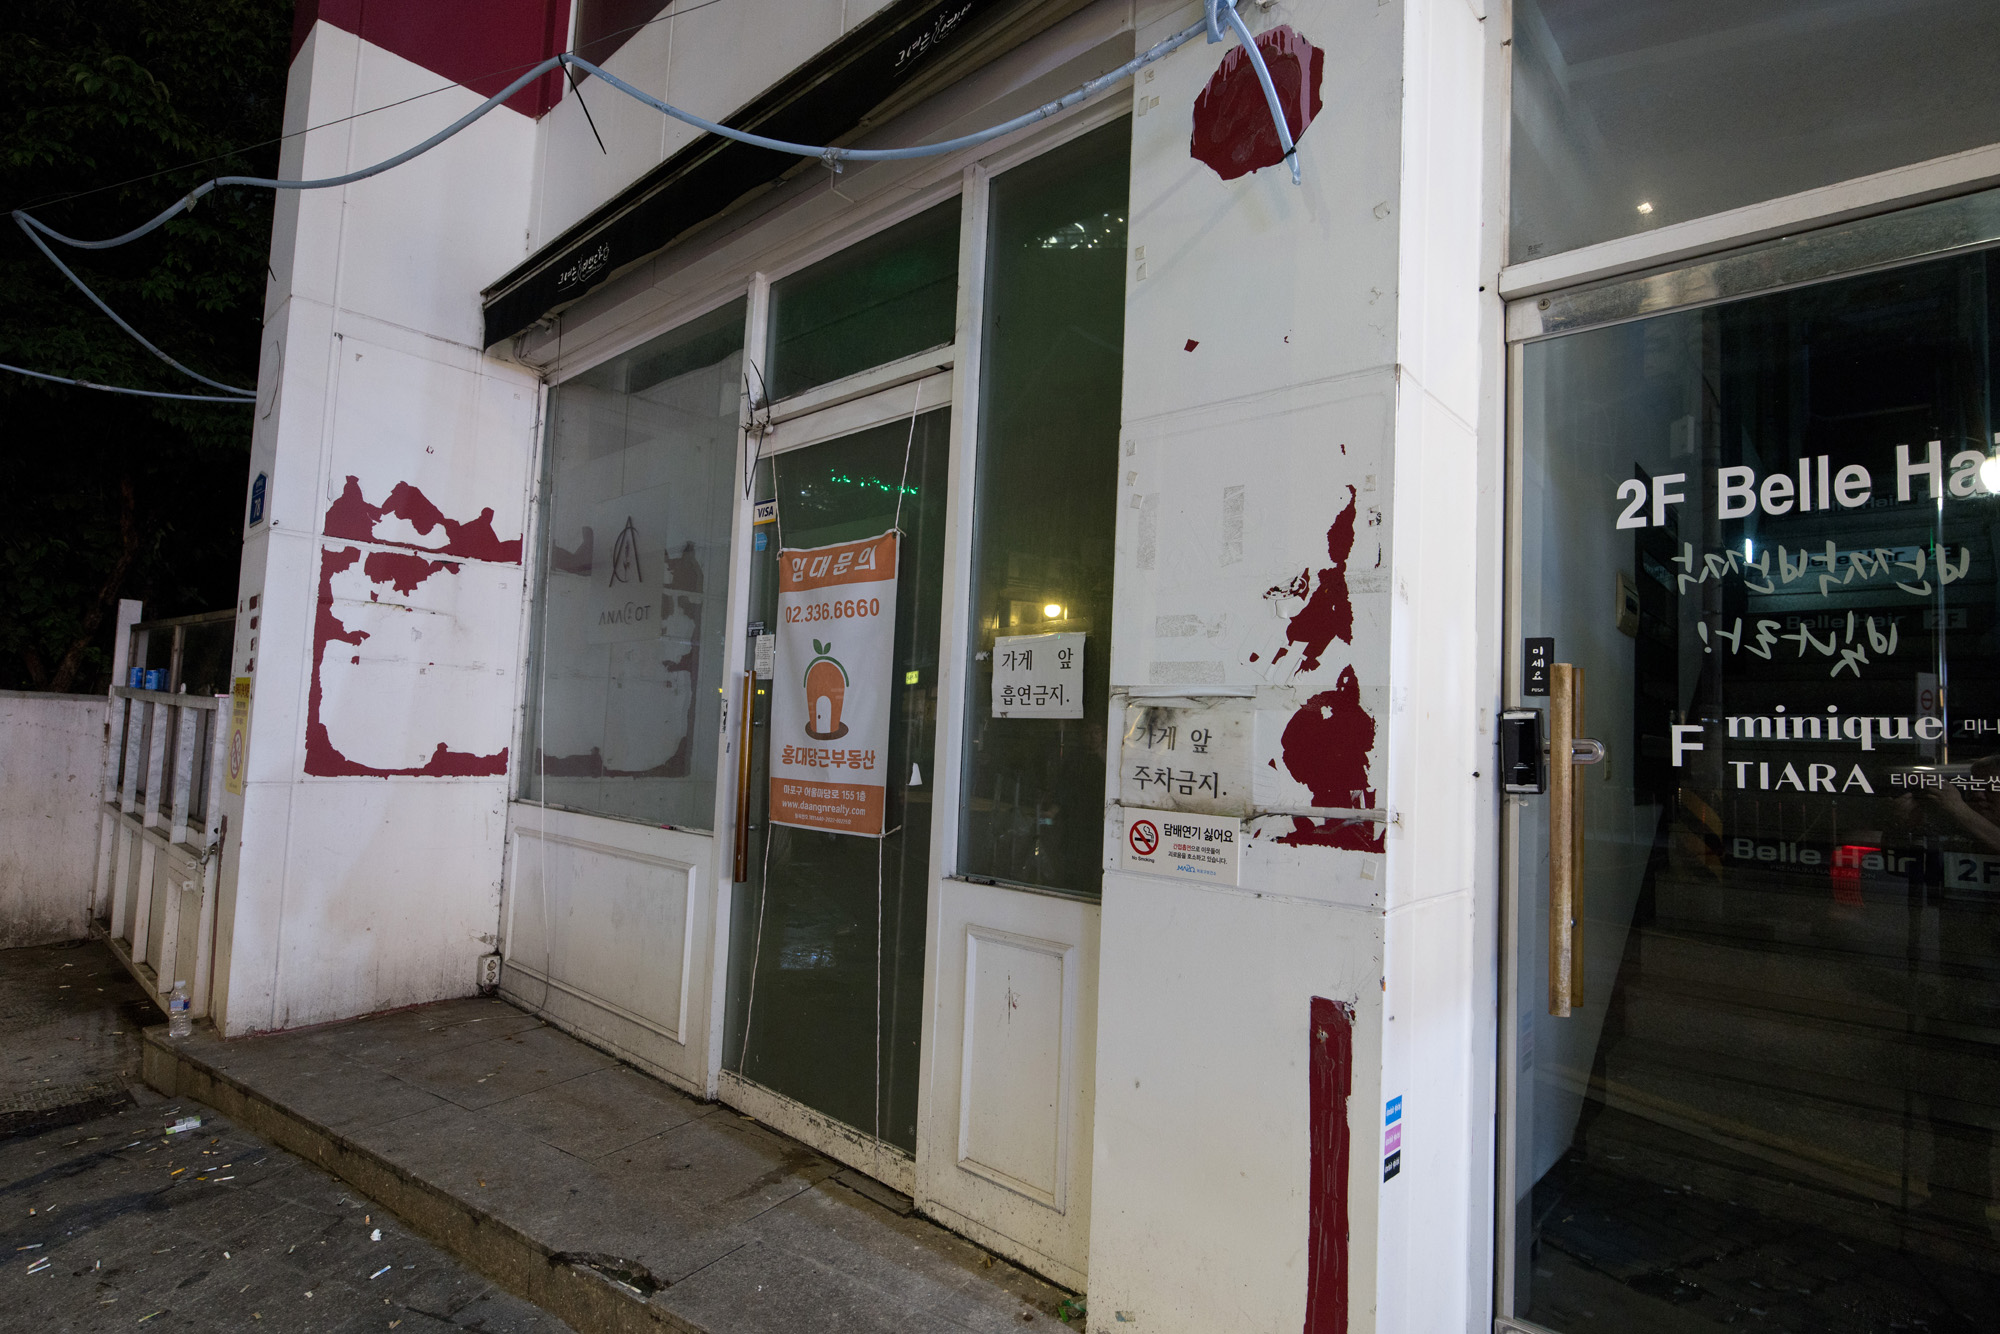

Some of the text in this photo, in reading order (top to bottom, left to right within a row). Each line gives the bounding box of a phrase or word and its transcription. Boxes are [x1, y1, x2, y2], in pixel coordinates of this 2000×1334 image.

[1616, 432, 2000, 529] 2F Belle Ha
[757, 505, 774, 518] VISA
[792, 545, 877, 582] 임대문의
[786, 598, 879, 623] 02.336.6660
[1001, 648, 1074, 671] 가게 앞
[1531, 645, 1545, 681] 미세요
[1000, 684, 1069, 706] 흡연금지.
[1135, 726, 1212, 753] 가게 앞
[1726, 705, 1943, 751] minique
[782, 744, 875, 770] 홍대당근부동산
[783, 784, 802, 795] 마포구
[1132, 765, 1227, 799] 주차금지.
[1727, 761, 1875, 793] TIARA
[1891, 772, 1944, 790] 티아라
[782, 800, 866, 816] www.daangnrealty.com
[1163, 823, 1234, 843] 담배연기 싫어요
[1138, 856, 1155, 864] Smoking
[1733, 837, 2000, 884] Belle Hair 2F
